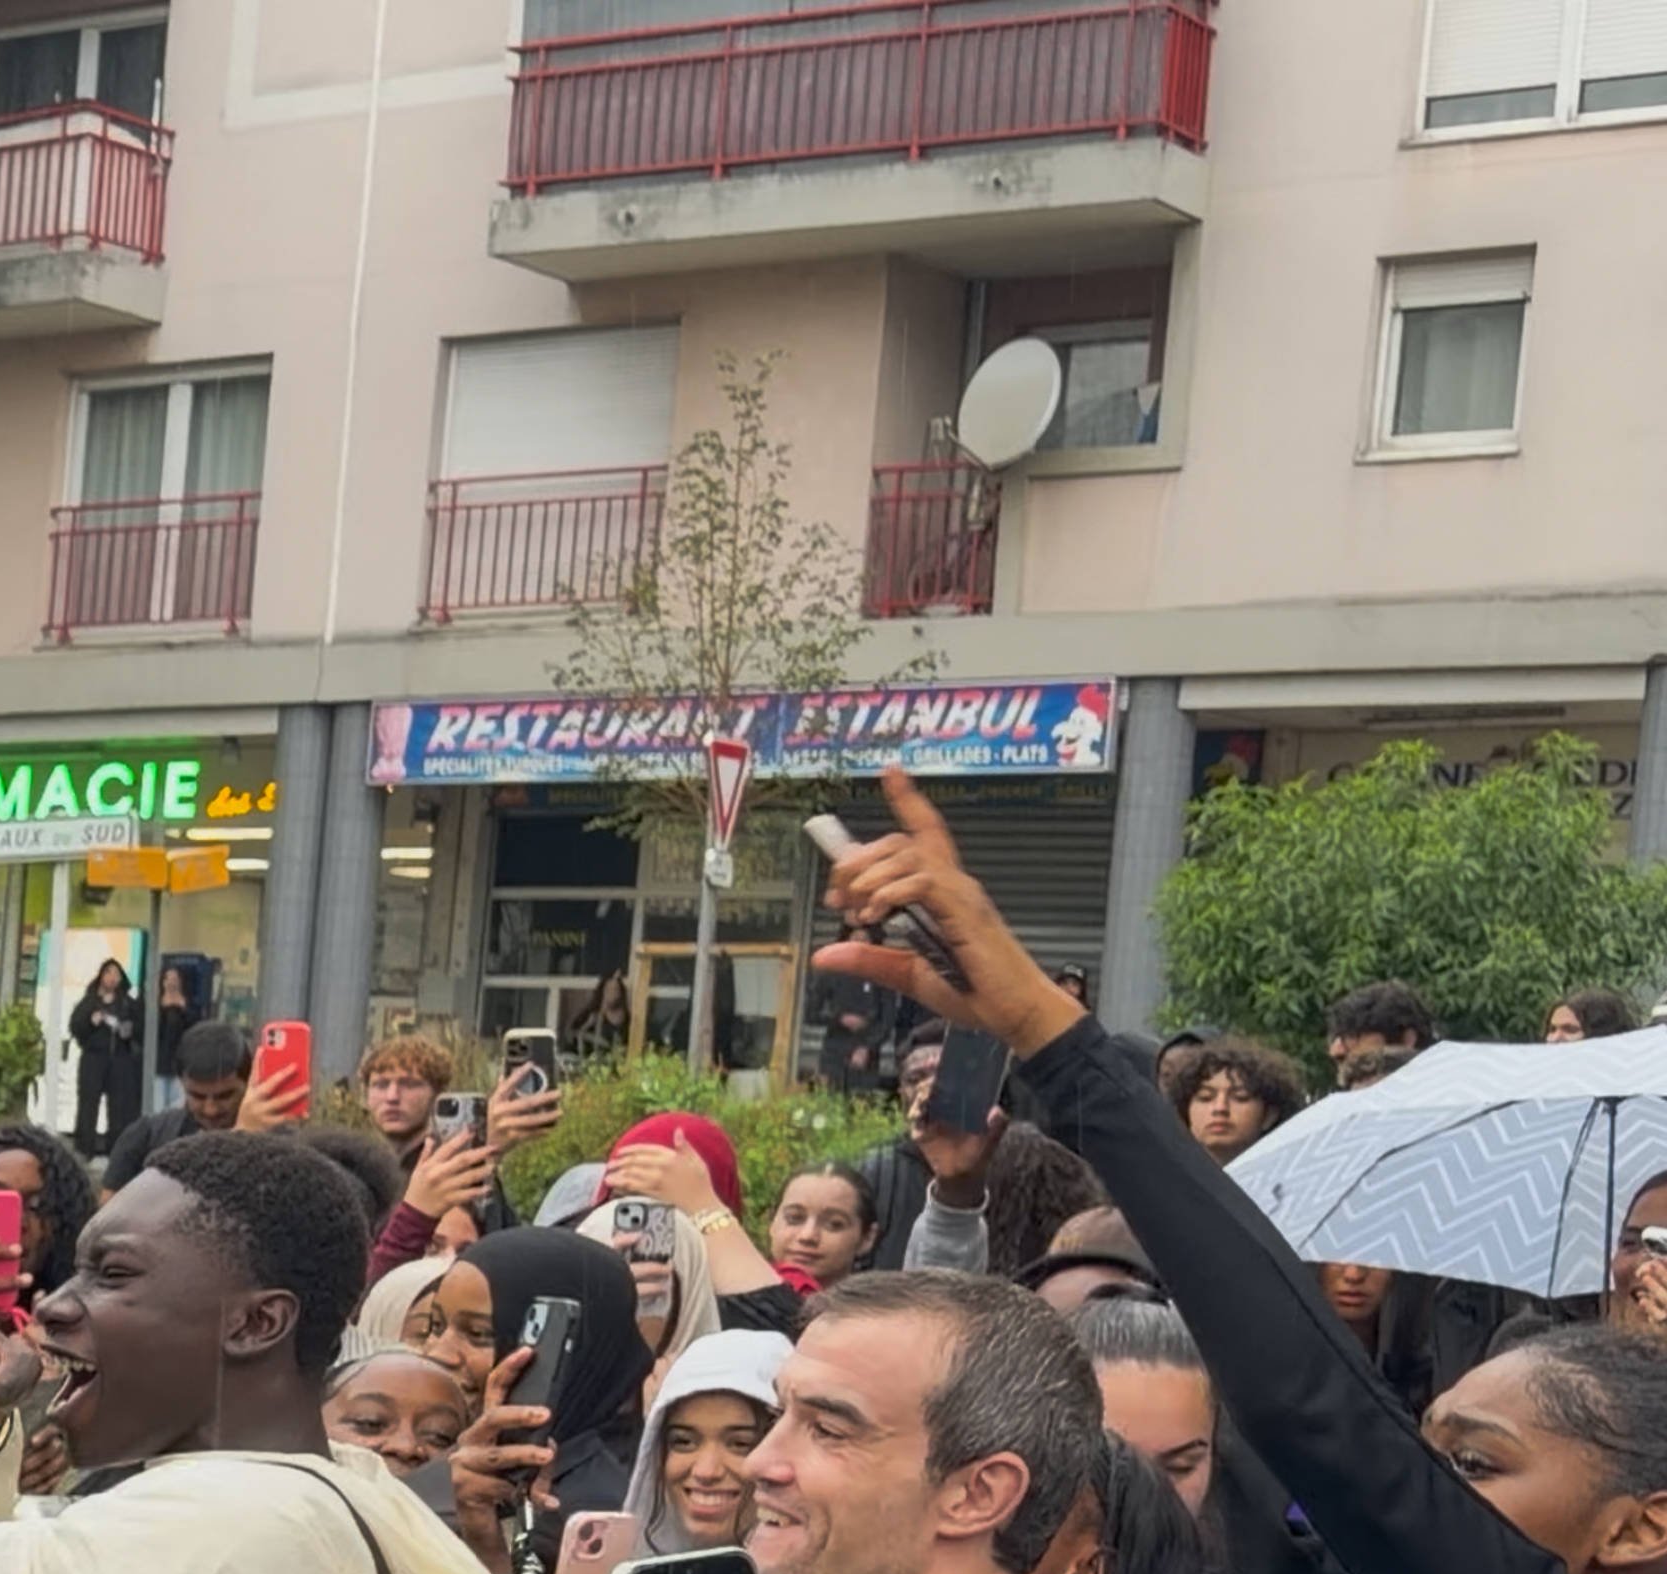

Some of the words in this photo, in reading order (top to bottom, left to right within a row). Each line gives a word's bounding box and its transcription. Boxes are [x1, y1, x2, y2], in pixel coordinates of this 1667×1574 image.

[784, 688, 1043, 746] ISTANBUL
[913, 746, 992, 765] GRILLADES
[1002, 744, 1048, 763] PLATS
[82, 823, 127, 845] SUD
